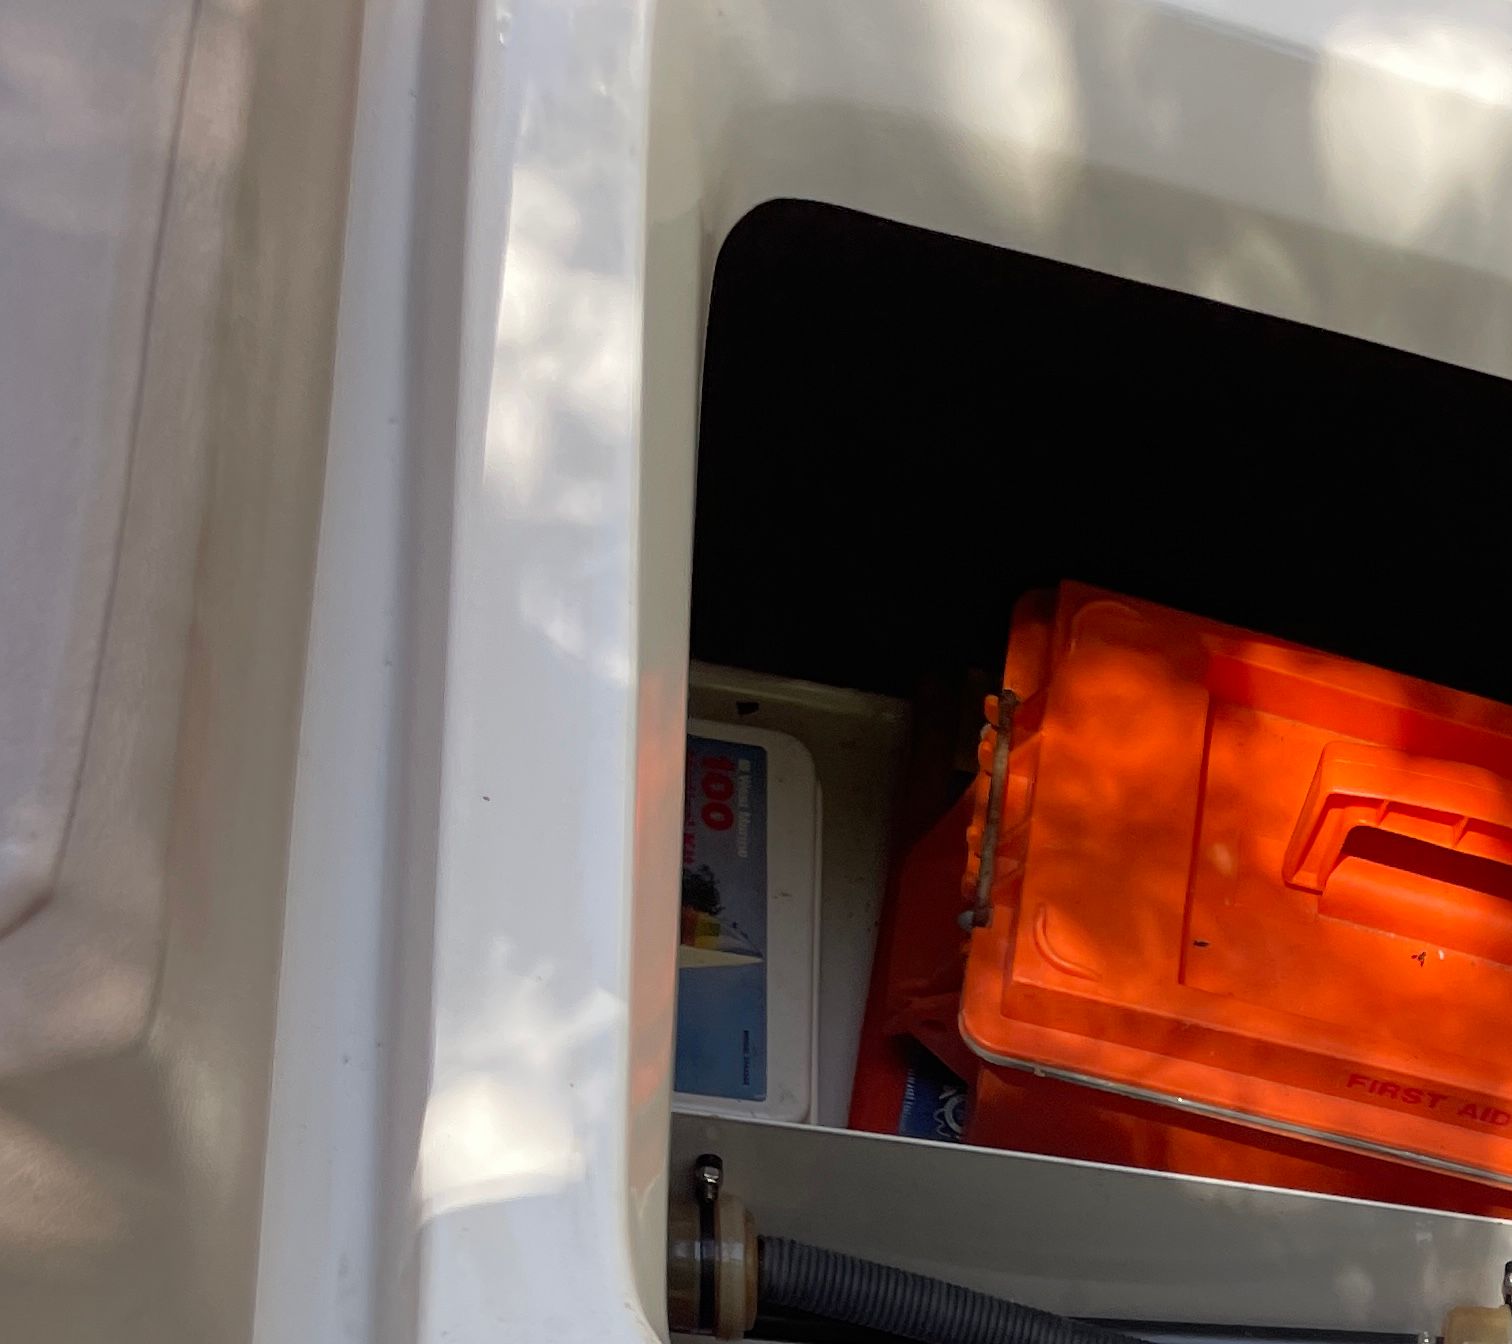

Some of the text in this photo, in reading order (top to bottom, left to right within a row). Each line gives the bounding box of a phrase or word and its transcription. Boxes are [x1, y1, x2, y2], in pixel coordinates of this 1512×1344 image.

[702, 756, 736, 832] 100
[1346, 1073, 1512, 1126] FIRST AID
